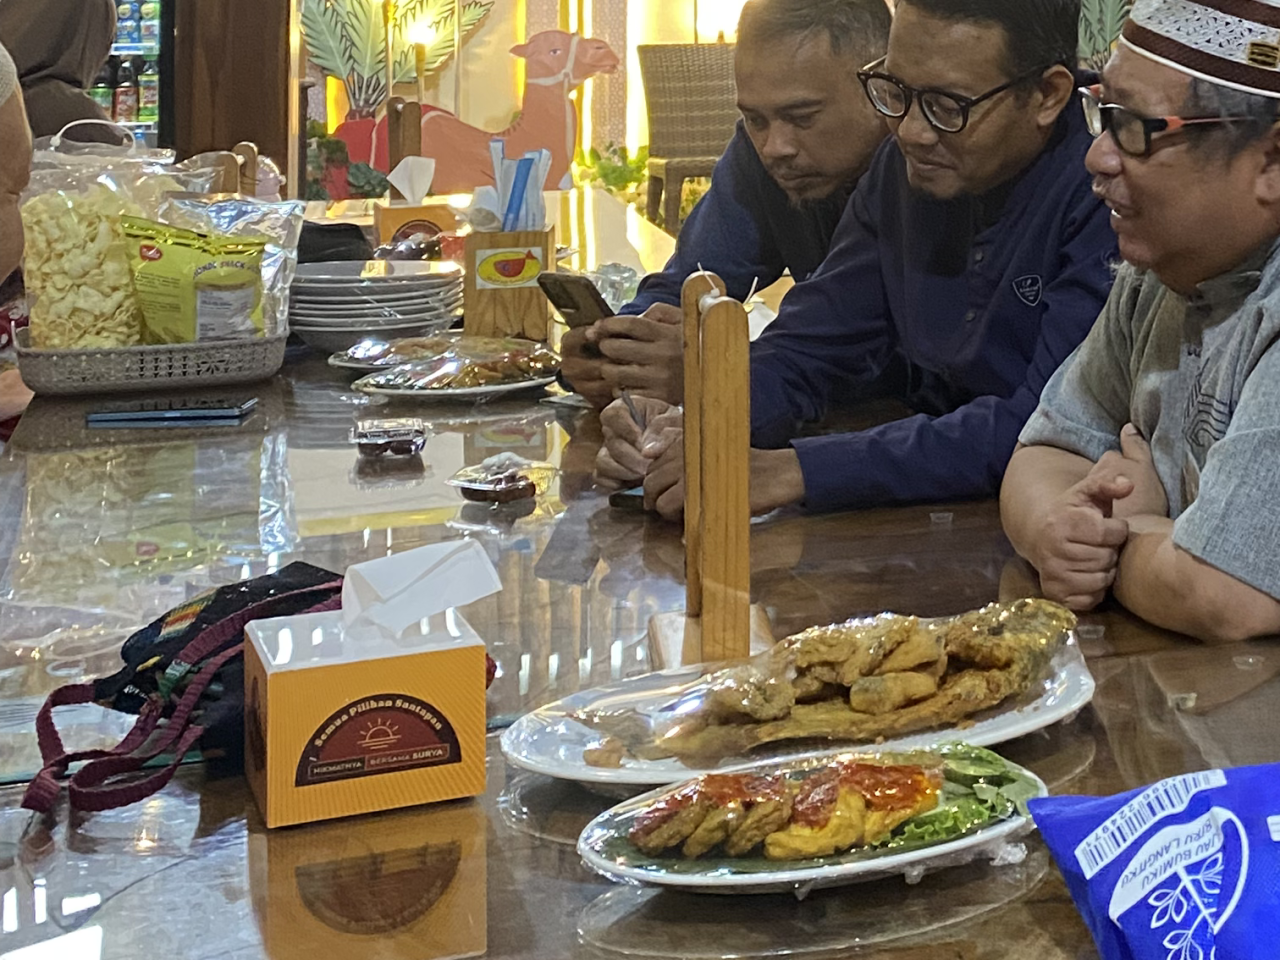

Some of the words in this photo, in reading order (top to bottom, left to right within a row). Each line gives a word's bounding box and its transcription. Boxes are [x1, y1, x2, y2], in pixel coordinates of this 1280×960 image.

[314, 712, 349, 747] Semua
[349, 699, 393, 716] Pilihan
[395, 698, 443, 731] Santapan
[412, 748, 444, 760] SURYA
[1184, 818, 1213, 846] BIRU
[1194, 831, 1221, 856] JAU
[1120, 836, 1181, 889] LANGITKU
[1140, 848, 1192, 890] BUMIKU
